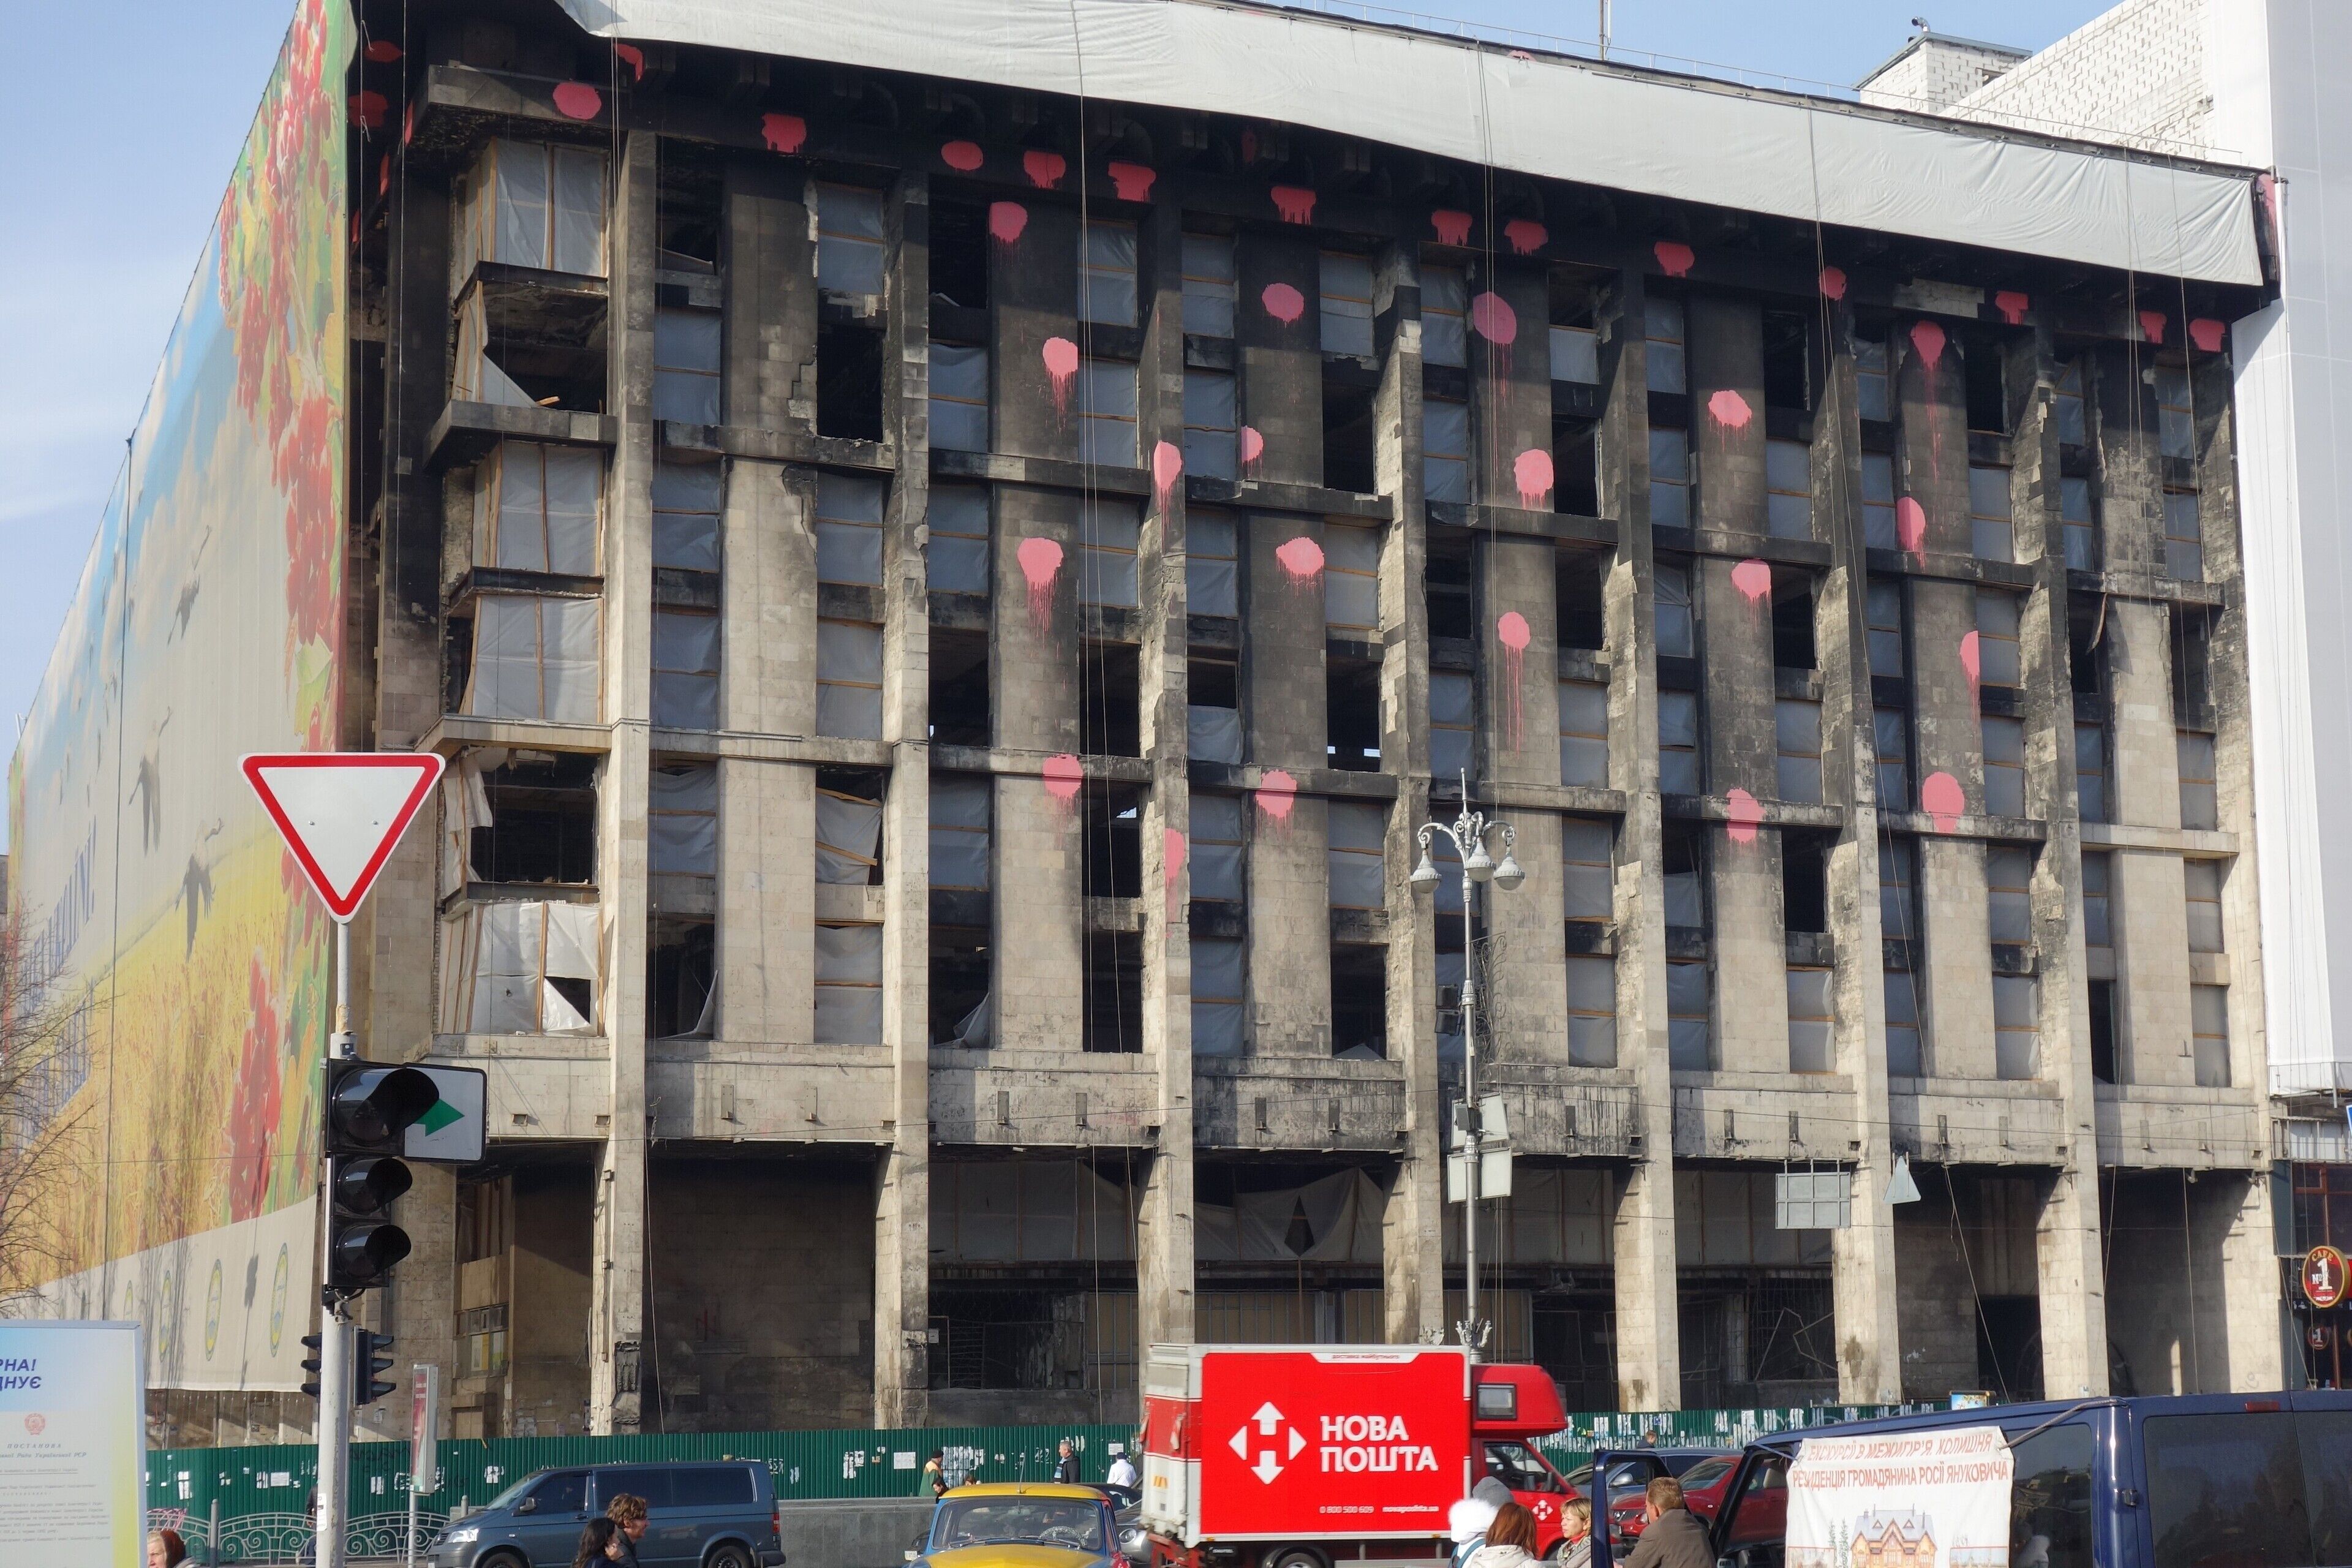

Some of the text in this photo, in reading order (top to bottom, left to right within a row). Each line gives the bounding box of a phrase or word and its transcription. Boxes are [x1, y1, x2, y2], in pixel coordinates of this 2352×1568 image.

[1320, 1415, 1409, 1441] НОВА
[1320, 1446, 1439, 1472] ПОШТА
[1807, 1441, 1857, 1461] ЕКСКУРСІЇ
[1855, 1444, 1866, 1460] В
[1936, 1433, 1993, 1455] КОЛИШНЯ
[1793, 1460, 2009, 1491] РЕЗИДЕНЦІЯ ГРОМАДЯНИНА РОСІЇ ЯНУКОВИЧА
